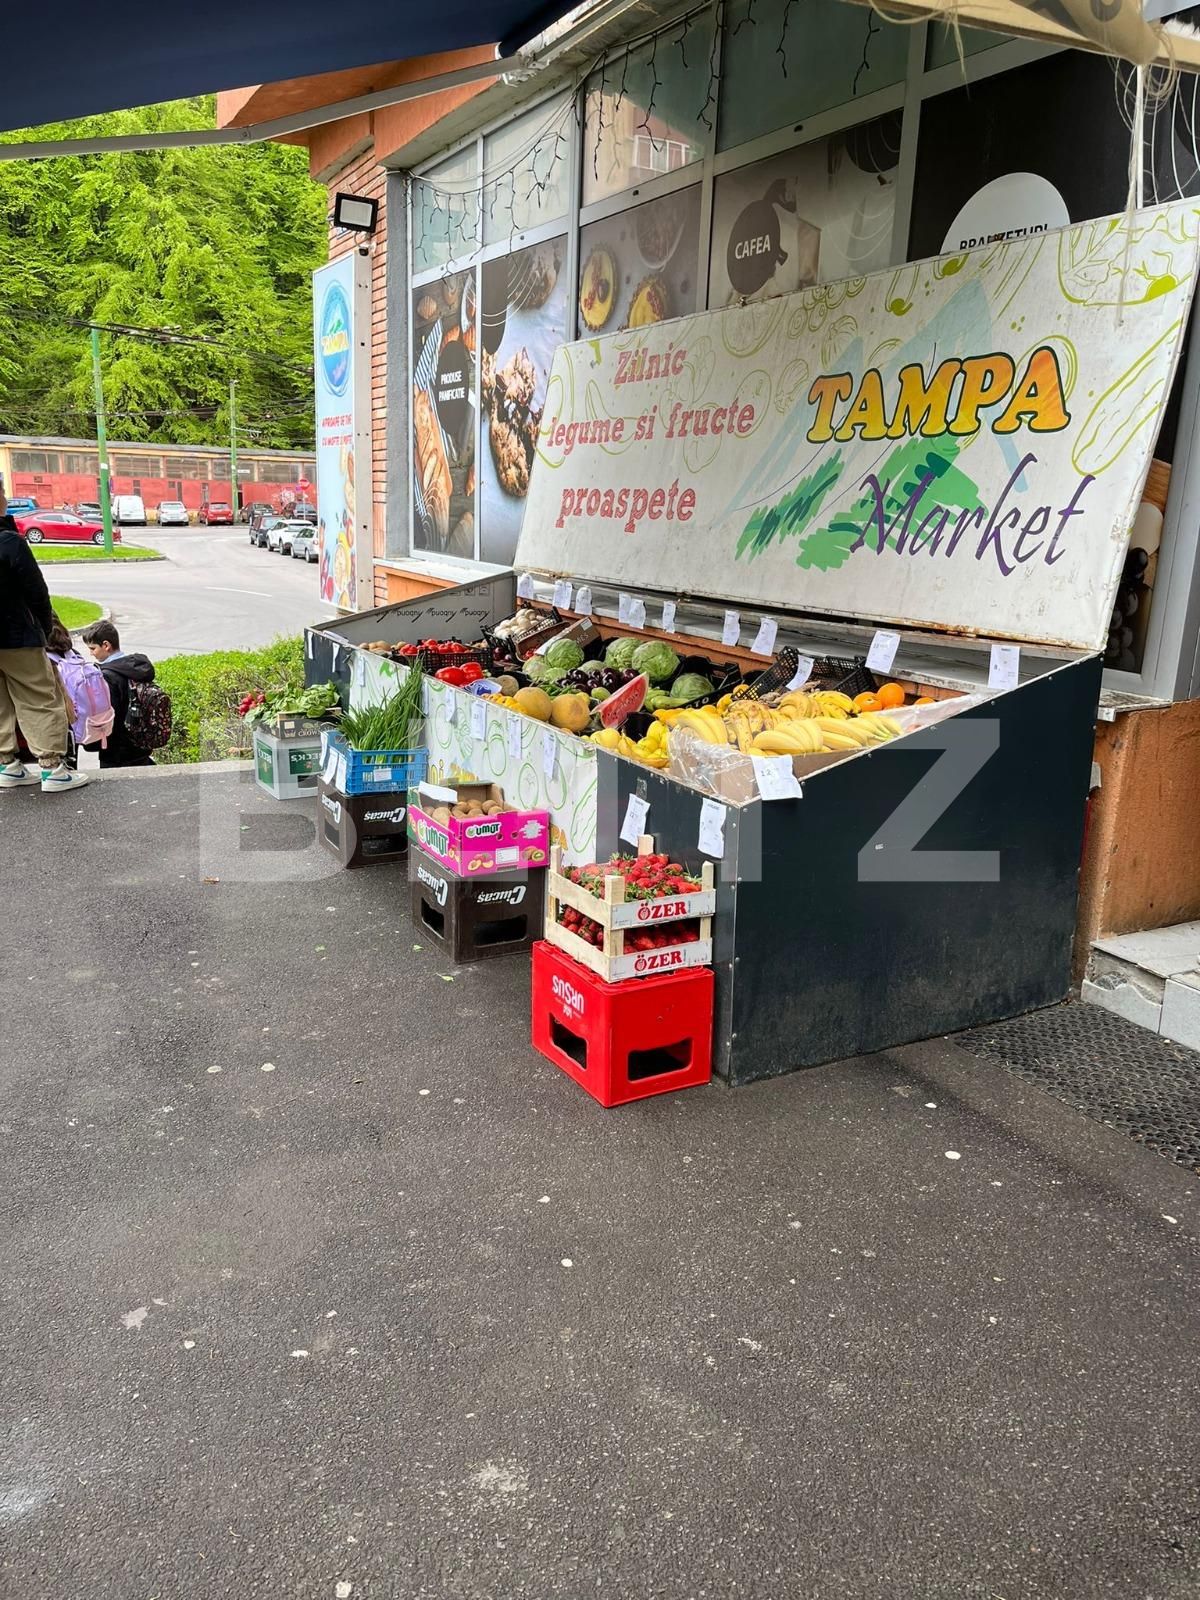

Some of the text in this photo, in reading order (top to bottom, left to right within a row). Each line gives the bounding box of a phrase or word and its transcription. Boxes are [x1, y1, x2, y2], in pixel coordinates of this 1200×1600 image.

[735, 234, 771, 260] CAFEA
[613, 342, 687, 385] Zilnic
[807, 346, 1071, 443] TAMPA
[547, 398, 755, 456] legume si fructe
[555, 478, 696, 533] proaspete
[850, 453, 1096, 577] Market
[637, 901, 687, 921] ÖZER
[634, 950, 683, 972] ÖZER
[552, 974, 585, 1015] URSUS
